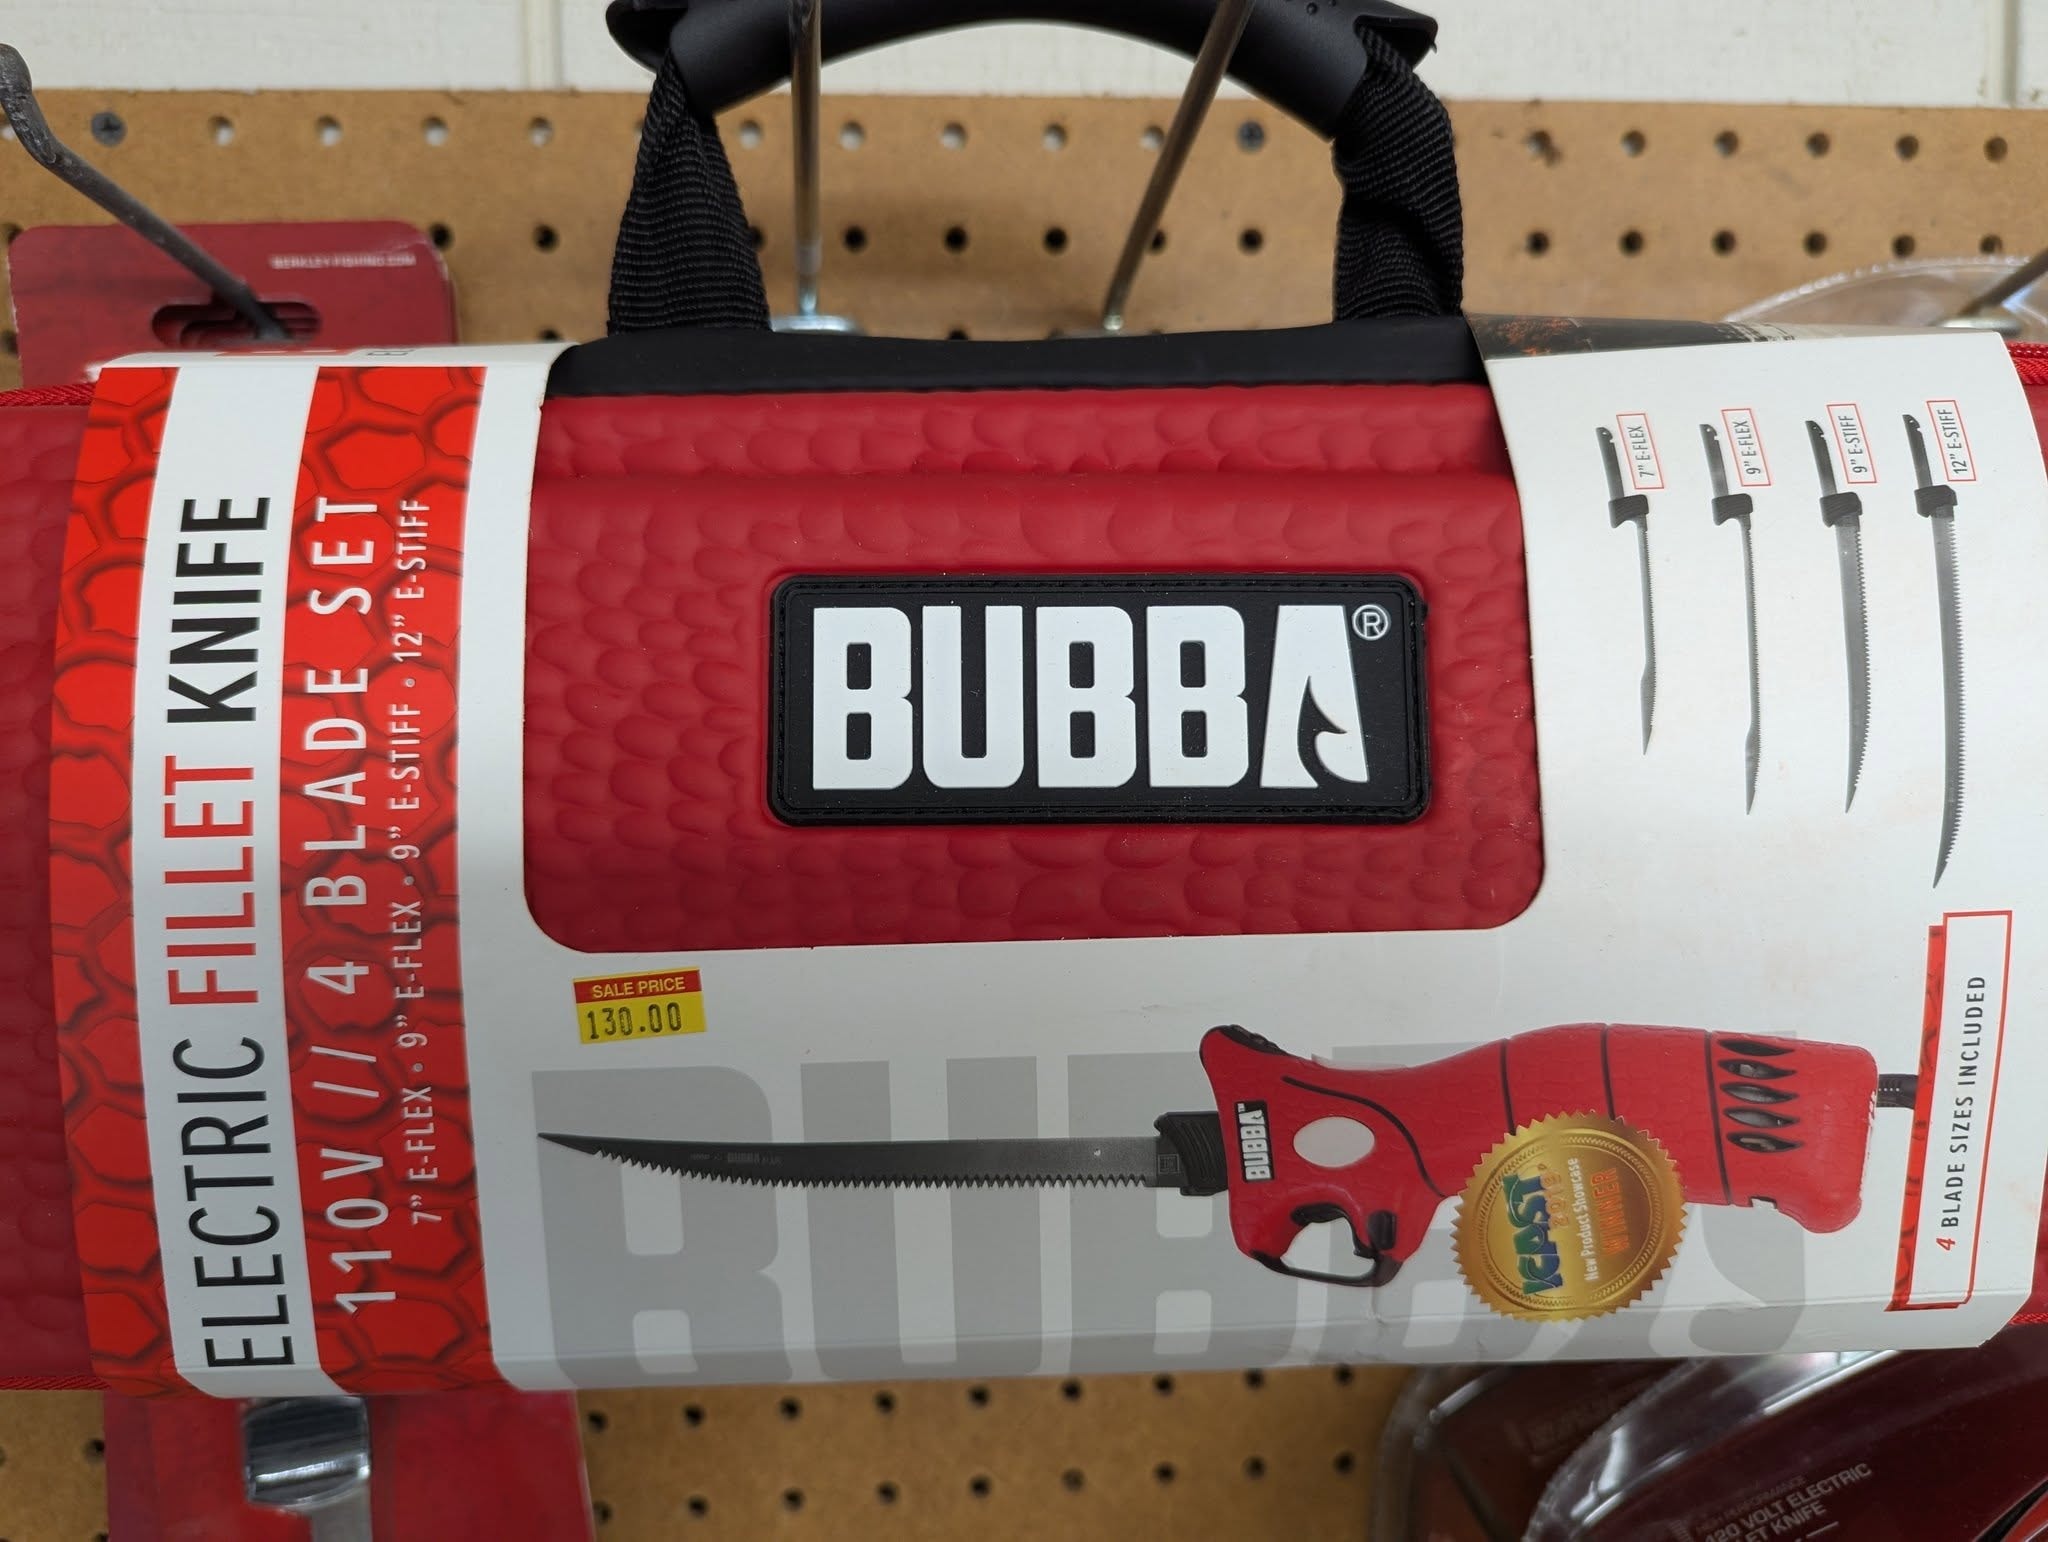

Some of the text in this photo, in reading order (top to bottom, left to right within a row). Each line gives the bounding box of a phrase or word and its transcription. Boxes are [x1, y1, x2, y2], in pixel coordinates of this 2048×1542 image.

[1627, 425, 1651, 461] E-FLEX
[1732, 420, 1757, 457] E-FLEX
[1838, 415, 1863, 456] E-STIFF
[1936, 409, 1962, 449] E-STIFF
[308, 497, 378, 615] SET
[394, 500, 430, 599] E-STIFF
[303, 668, 368, 906] BLADE
[389, 703, 421, 809] E-STIFF
[164, 497, 295, 1368] ELECTRIC FILLET KNIFE
[307, 961, 370, 995] 4
[391, 901, 425, 999] E-FLEX
[586, 1002, 682, 1040] 130.00
[592, 976, 686, 999] SALE PRICE
[401, 1086, 439, 1181] E-FLEX
[1238, 1109, 1271, 1180] BUBBA
[1936, 976, 1986, 1251] 4 BLADE SIZES INCLUDED
[320, 1148, 396, 1314] 110V
[1502, 1174, 1563, 1295] ICAST
[1567, 1157, 1599, 1281] New Product Showcase
[1591, 1167, 1629, 1256] WINNER
[1741, 1499, 1785, 1529] VOLT
[1786, 1463, 1872, 1508] ELECTRIC
[1770, 1500, 1827, 1535] KNIFE
